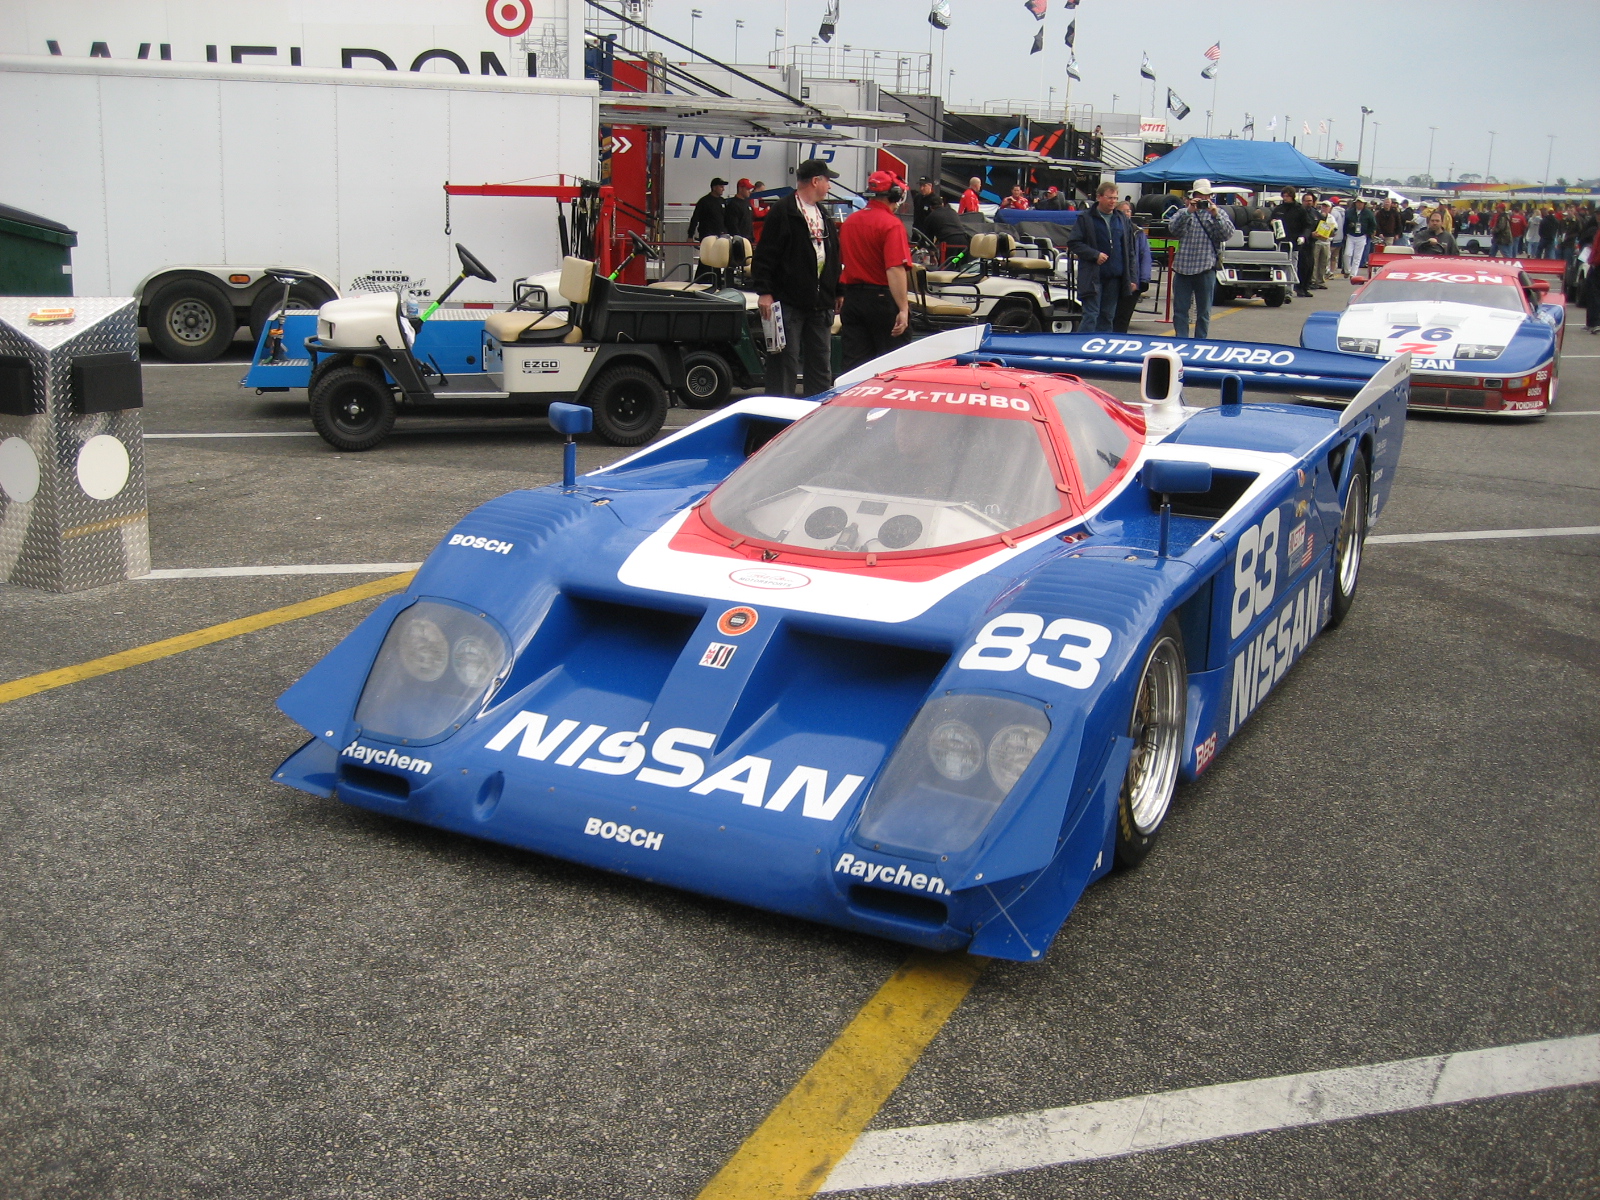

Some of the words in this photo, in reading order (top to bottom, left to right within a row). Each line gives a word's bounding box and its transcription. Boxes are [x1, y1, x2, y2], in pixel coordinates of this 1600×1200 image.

[1386, 271, 1503, 284] EXXON
[1081, 338, 1142, 355] GTP
[1386, 325, 1454, 342] 76
[1395, 343, 1438, 355] Z
[841, 385, 883, 398] GTP
[882, 388, 1031, 412] ZX-TURBO
[448, 533, 514, 555] BOSCH
[1231, 507, 1280, 640] 83
[958, 612, 1113, 690] 83
[1228, 568, 1323, 738] NISSAN
[484, 709, 865, 822] NISSAN
[1196, 732, 1217, 773] BBS
[584, 817, 664, 851] BOSCH
